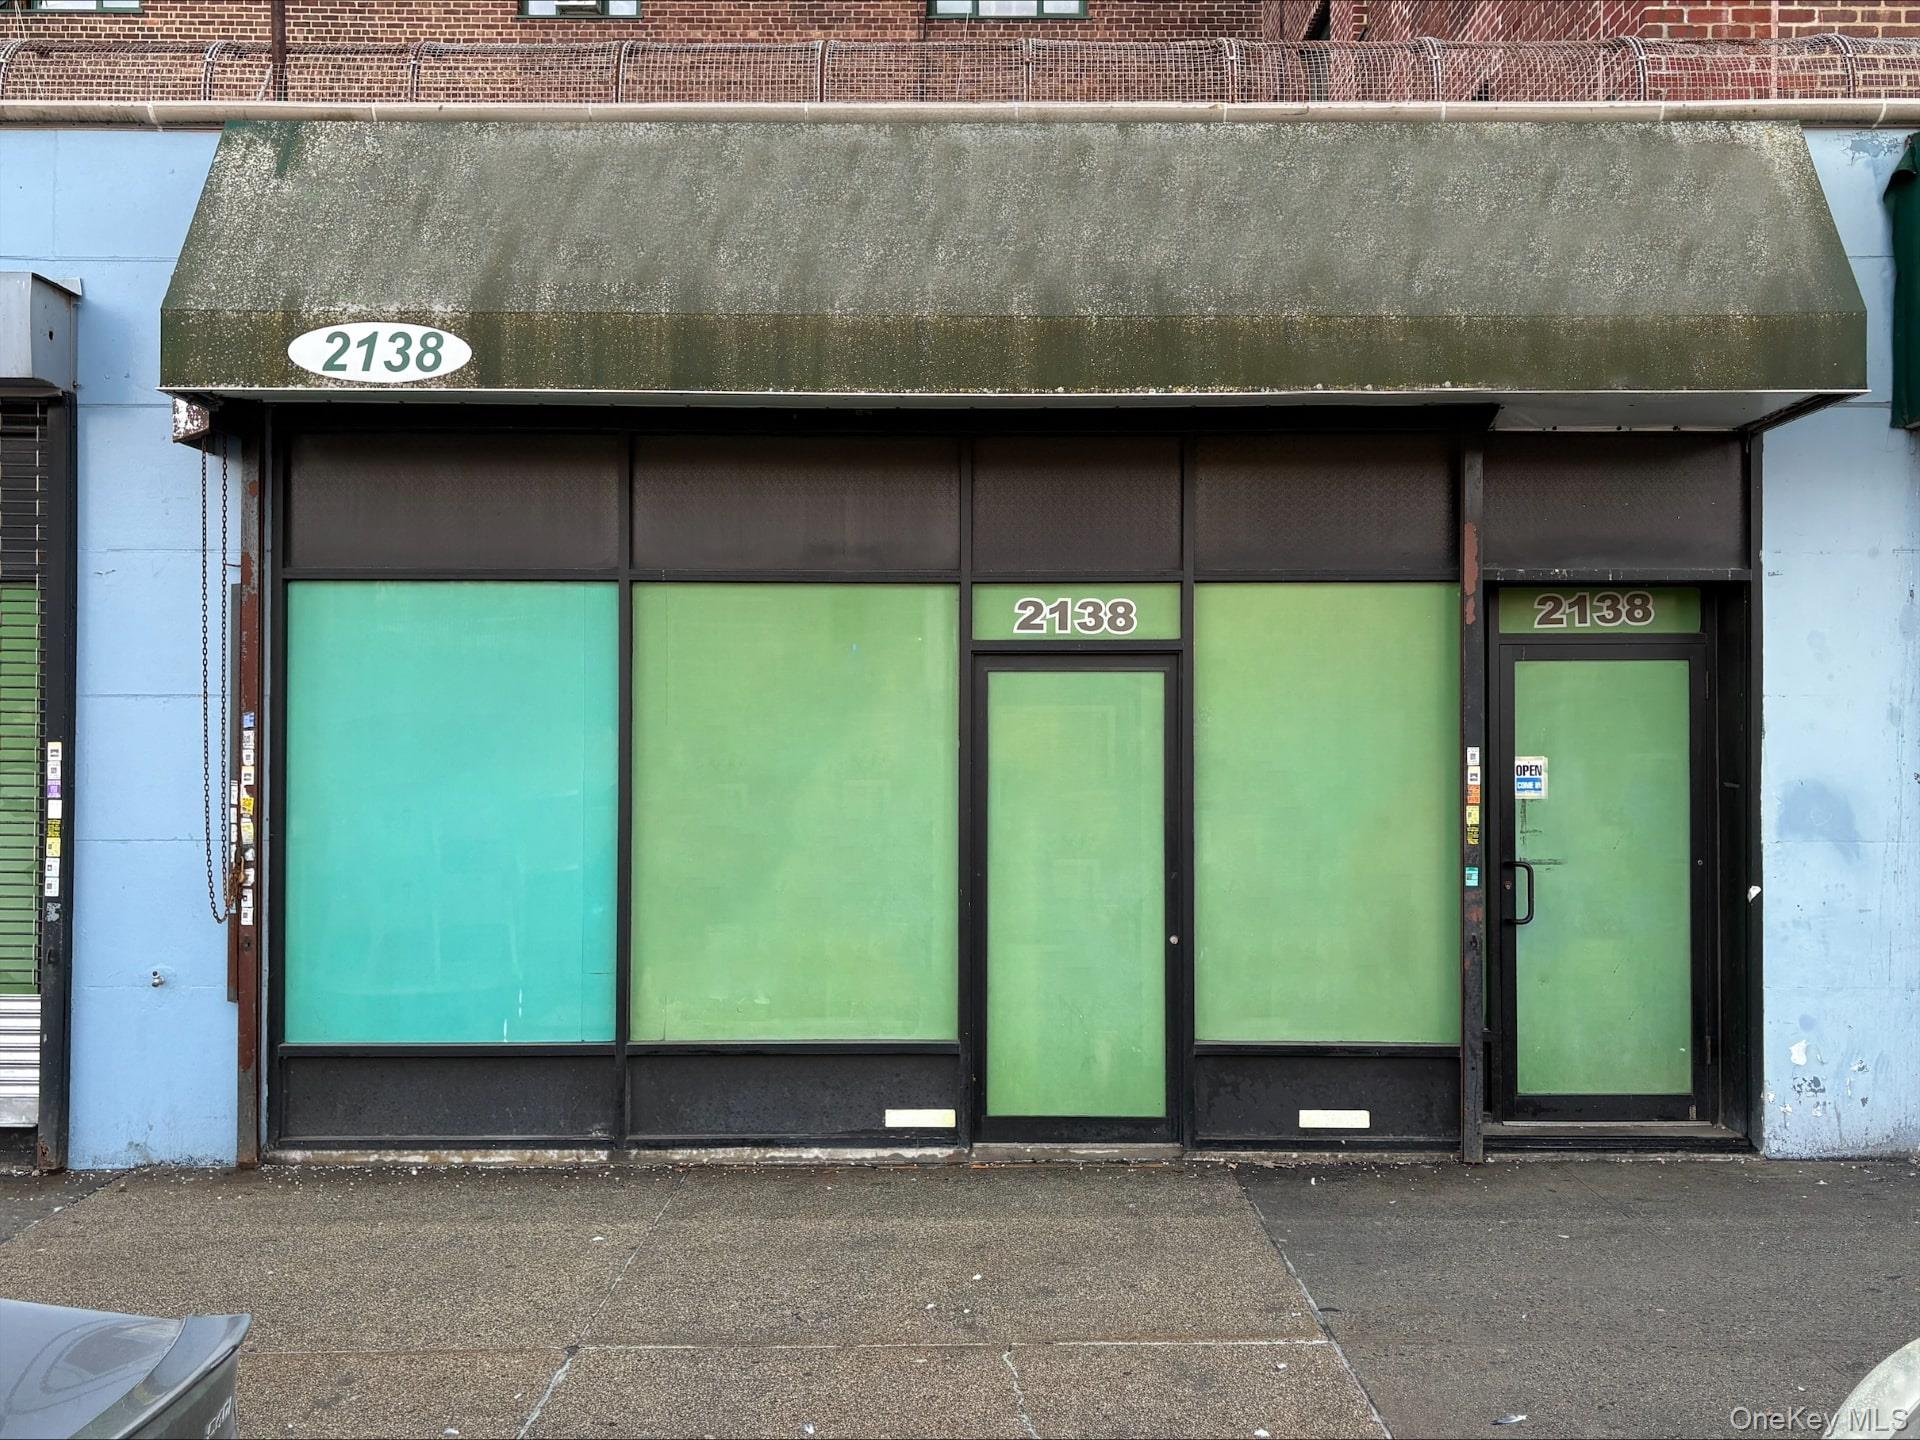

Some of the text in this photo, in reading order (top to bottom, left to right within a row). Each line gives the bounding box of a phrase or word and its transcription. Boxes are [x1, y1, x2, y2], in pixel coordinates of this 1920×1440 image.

[322, 331, 444, 372] 2138
[1013, 598, 1137, 634] 2138
[1534, 591, 1654, 628] 2138
[1516, 765, 1542, 776] OPEN
